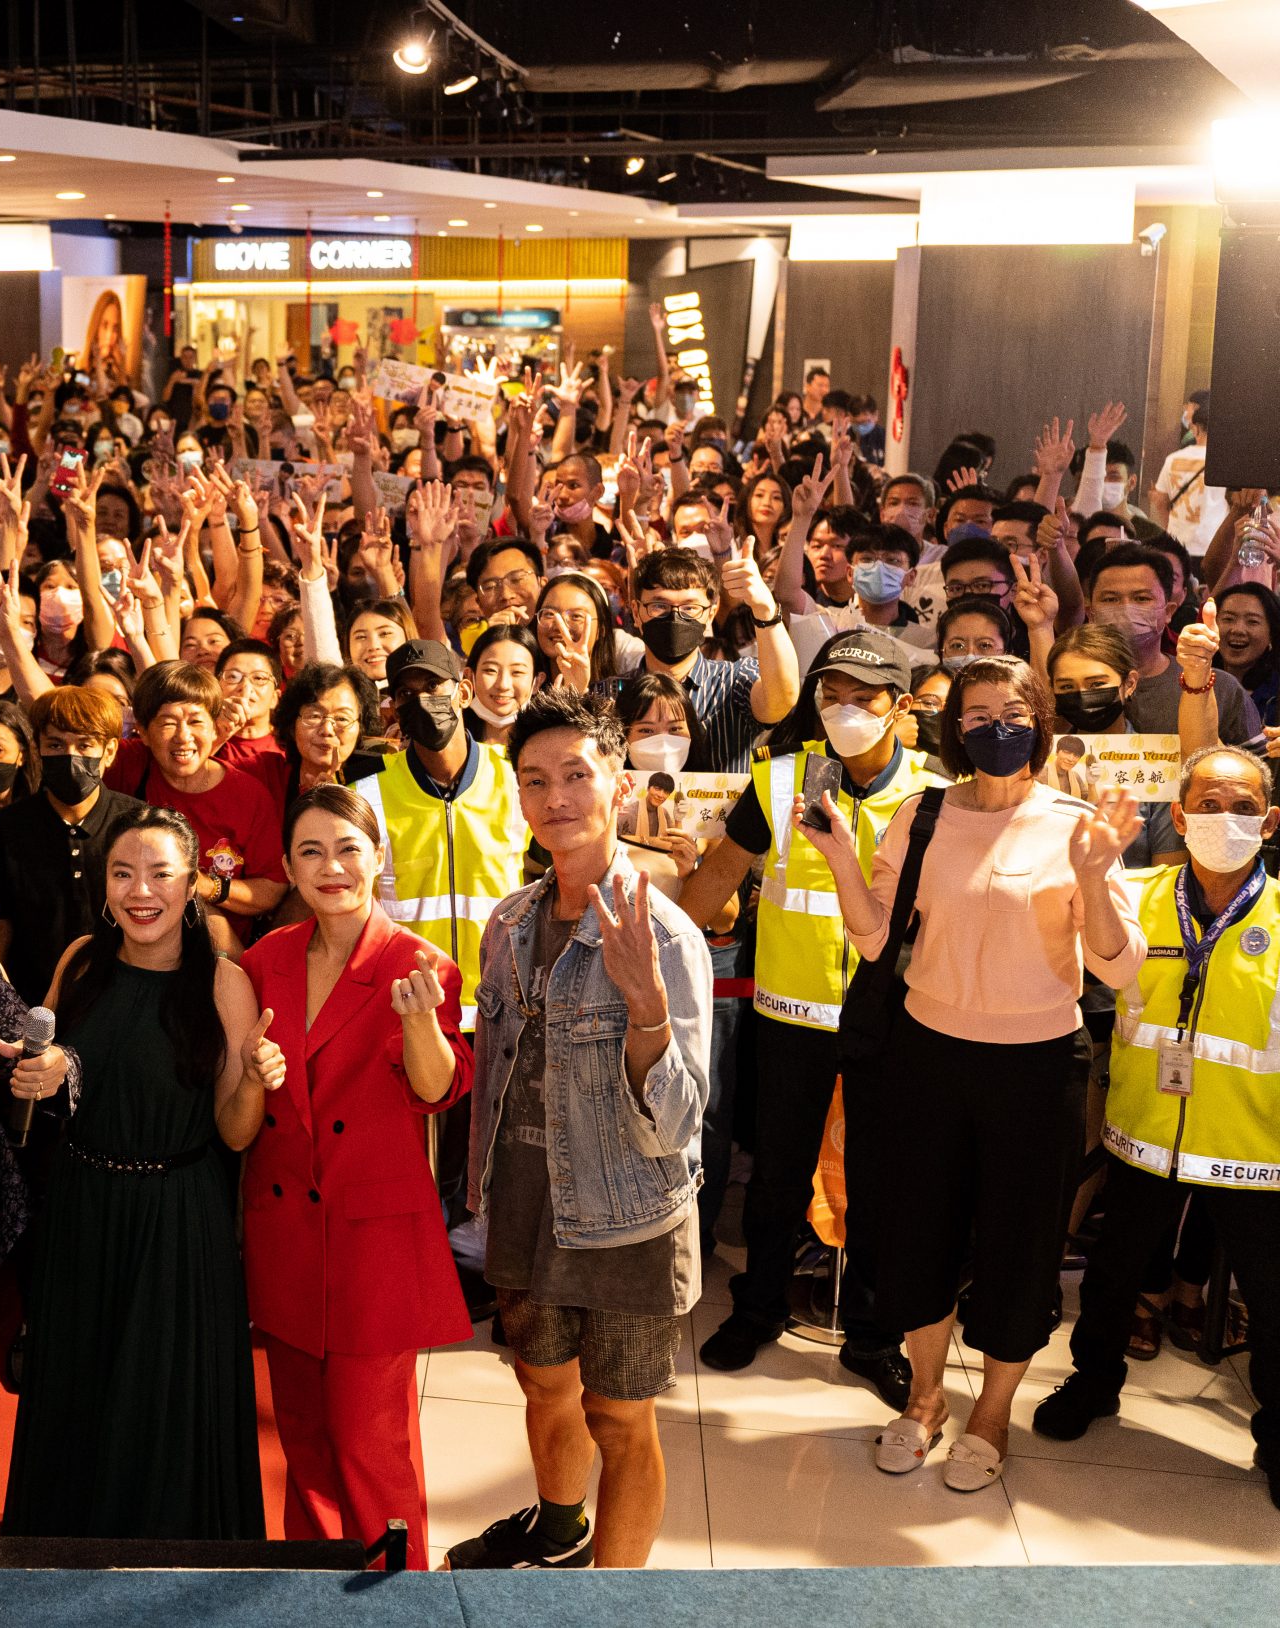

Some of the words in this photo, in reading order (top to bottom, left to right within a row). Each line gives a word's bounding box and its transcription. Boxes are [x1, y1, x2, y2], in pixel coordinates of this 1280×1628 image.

[215, 242, 290, 270] MOVIE
[310, 240, 412, 269] CORNER
[664, 291, 705, 345] BOX
[828, 647, 884, 665] SECURITY
[1099, 751, 1140, 761] Glenn
[1143, 751, 1180, 763] Yong
[1115, 770, 1166, 784] 容启航
[1216, 889, 1249, 930] MALAYSIA
[756, 990, 810, 1017] SECURITY
[1210, 1164, 1280, 1181] SECURIT
